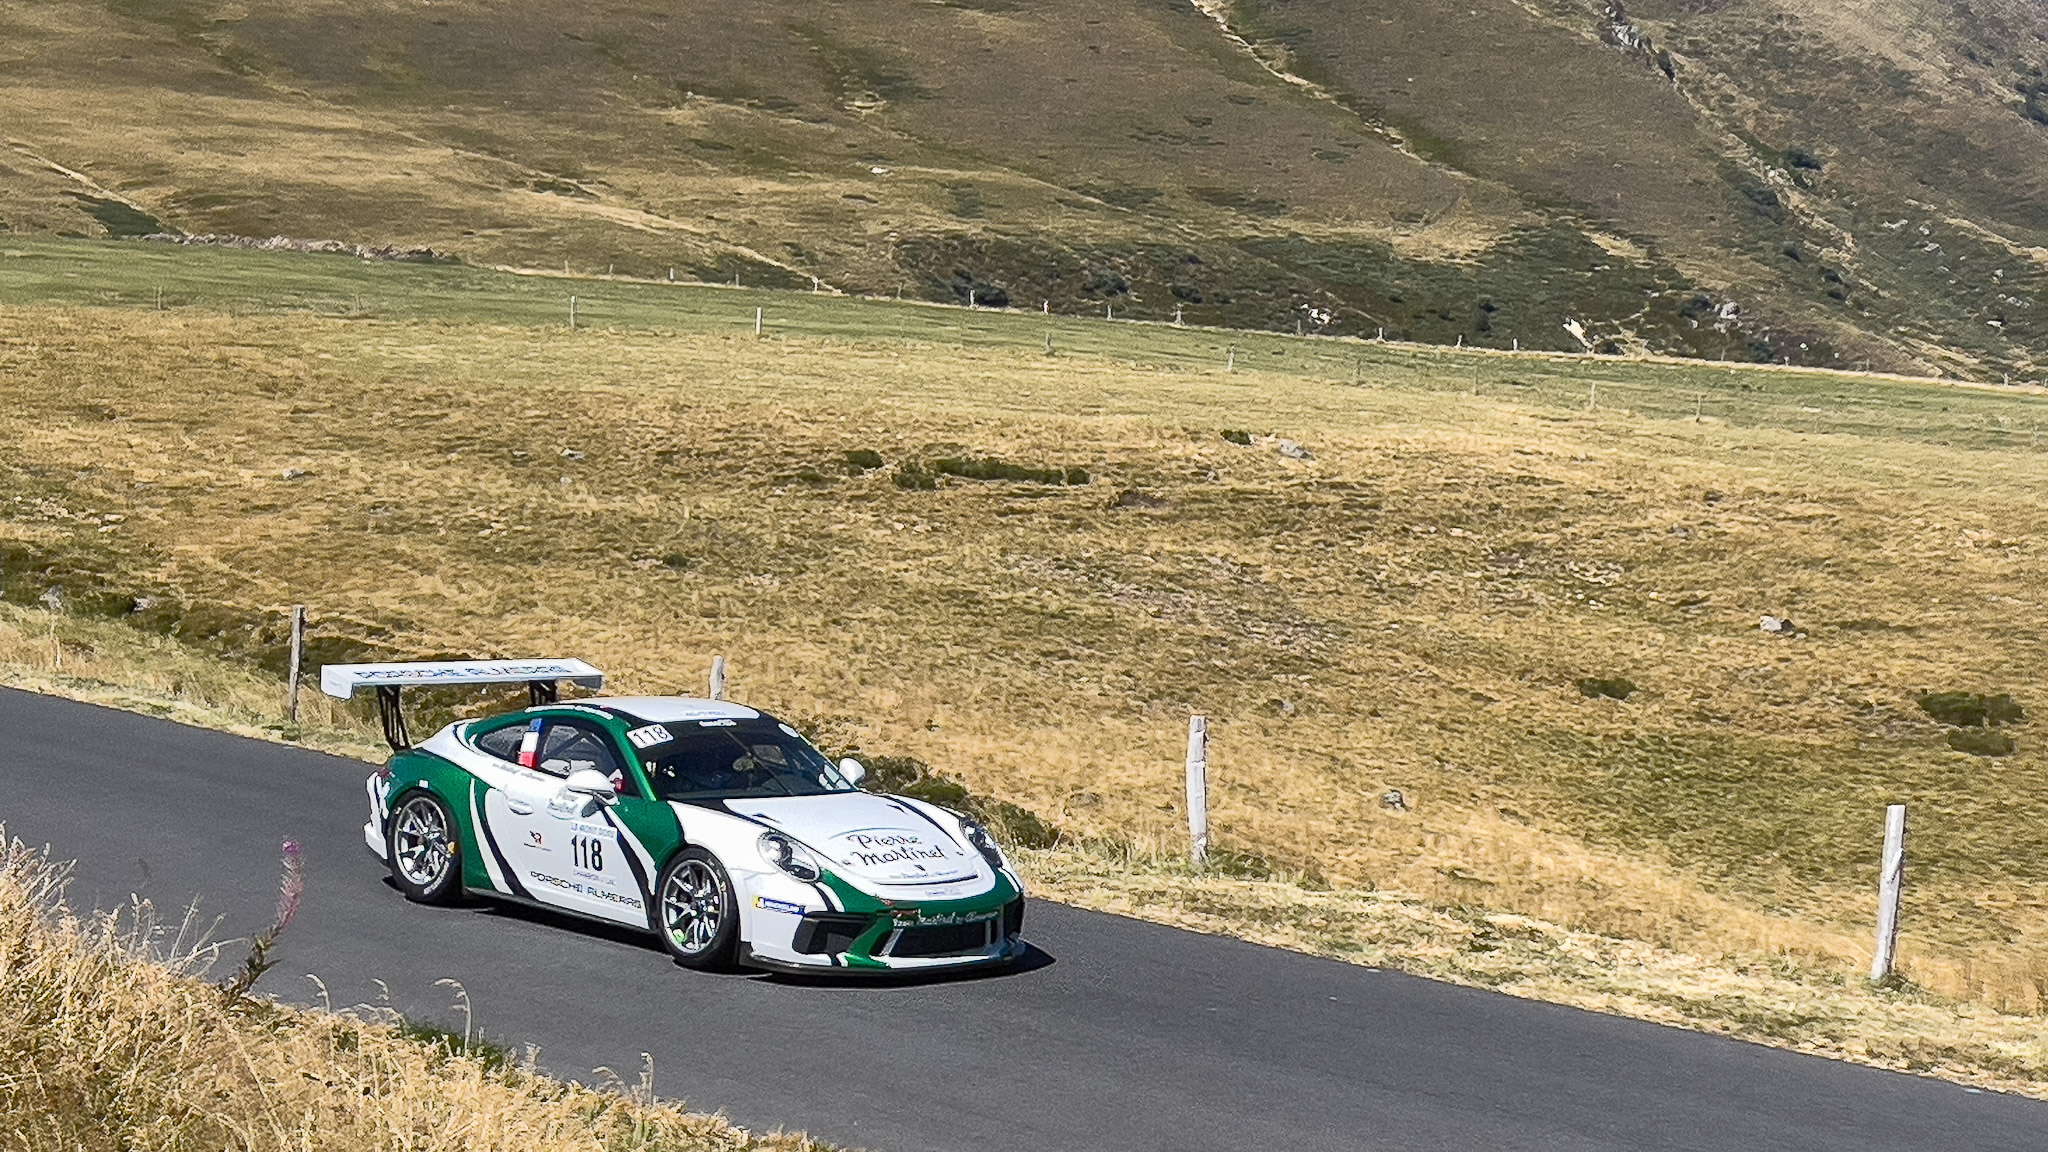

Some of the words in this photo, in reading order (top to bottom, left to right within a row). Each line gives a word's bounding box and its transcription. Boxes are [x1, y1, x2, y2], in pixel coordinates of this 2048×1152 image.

[632, 726, 669, 745] 118
[845, 833, 922, 850] Pierre
[571, 834, 603, 872] 118
[849, 844, 950, 866] Martinet
